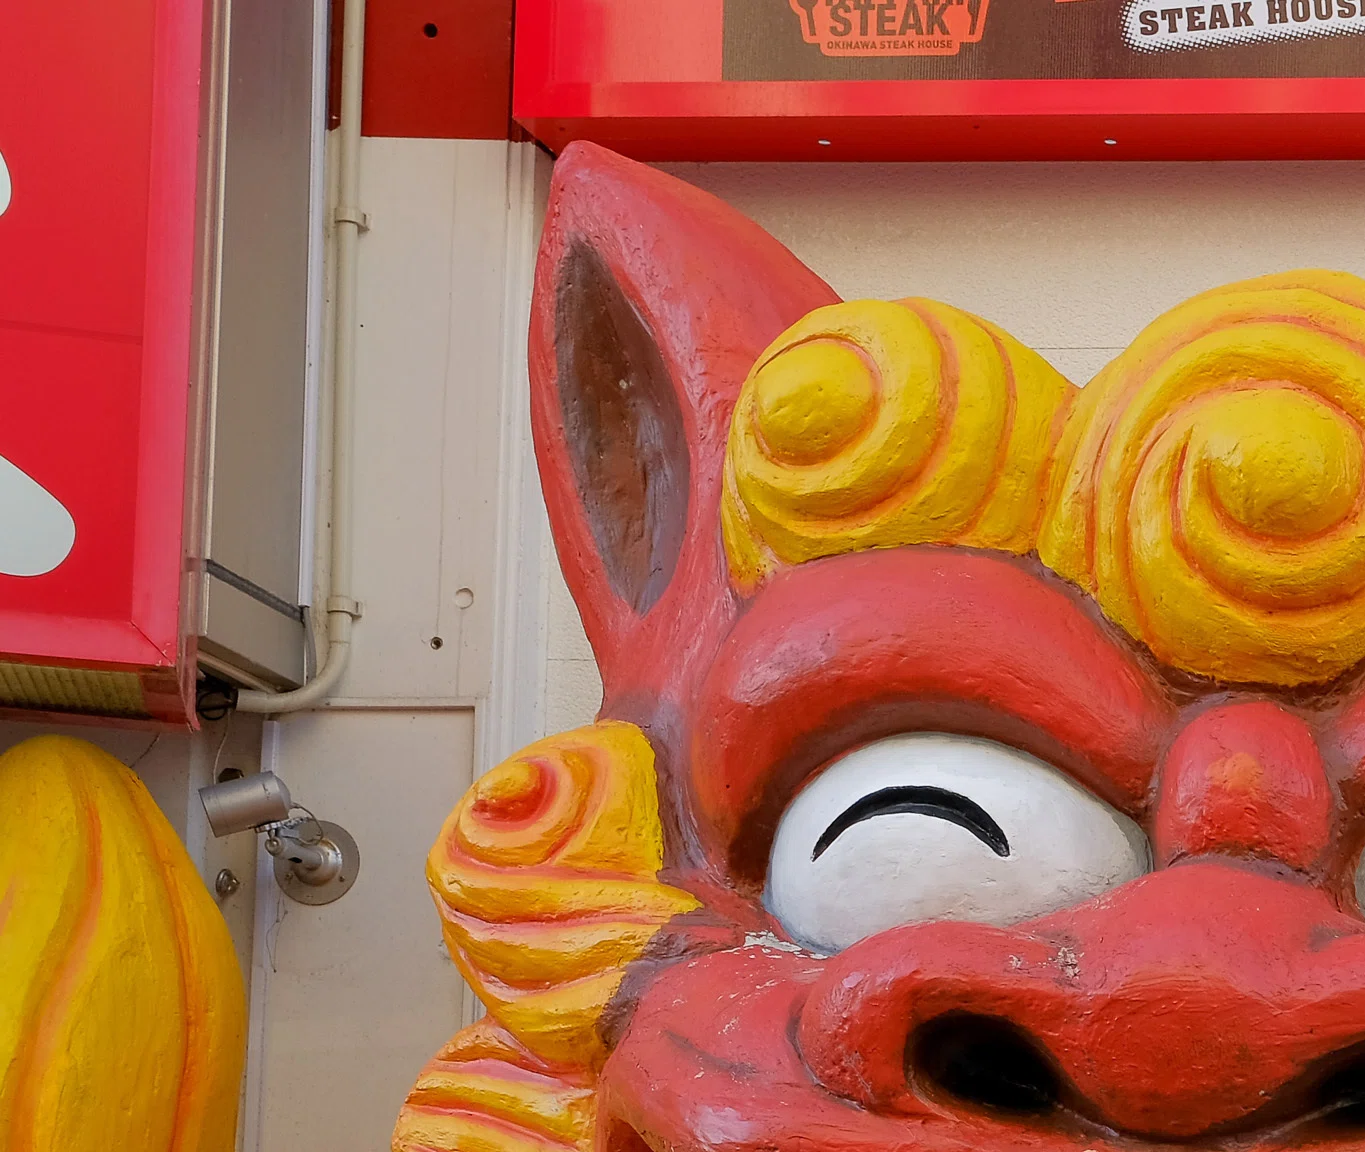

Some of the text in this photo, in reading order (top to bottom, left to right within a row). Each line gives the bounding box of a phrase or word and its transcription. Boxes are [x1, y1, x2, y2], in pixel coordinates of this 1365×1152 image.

[829, 1, 951, 37] STEAK
[1139, 2, 1254, 36] STEAK
[826, 39, 953, 50] OKINAWA STEAK HOUSE
